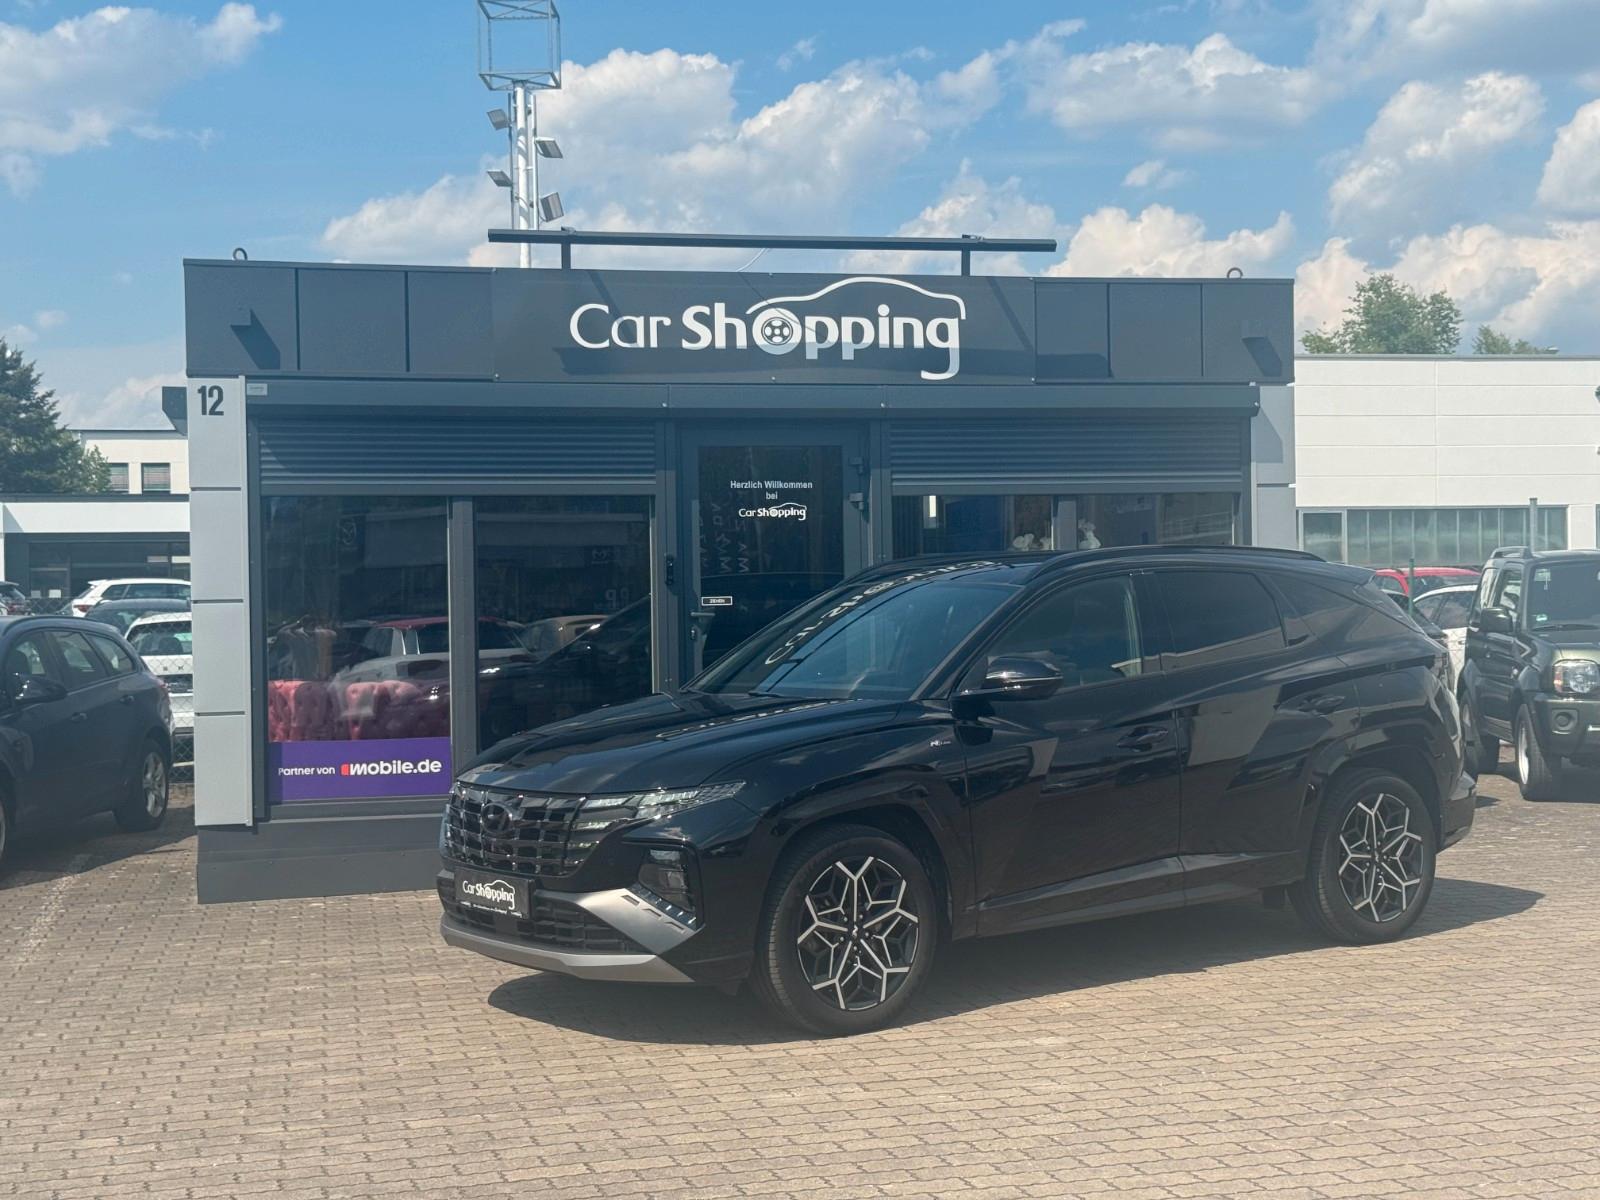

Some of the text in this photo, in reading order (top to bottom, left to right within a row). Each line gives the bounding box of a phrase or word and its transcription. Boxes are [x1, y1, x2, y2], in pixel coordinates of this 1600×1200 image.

[569, 302, 961, 380] Car Shopping
[197, 385, 224, 416] 12
[730, 480, 813, 489] Herzlich Willkommen
[765, 491, 778, 500] bei
[738, 506, 807, 521] Car Shopping
[278, 759, 442, 776] Partner von mobile.de
[462, 880, 476, 895] Car
[475, 883, 515, 910] Shopping
